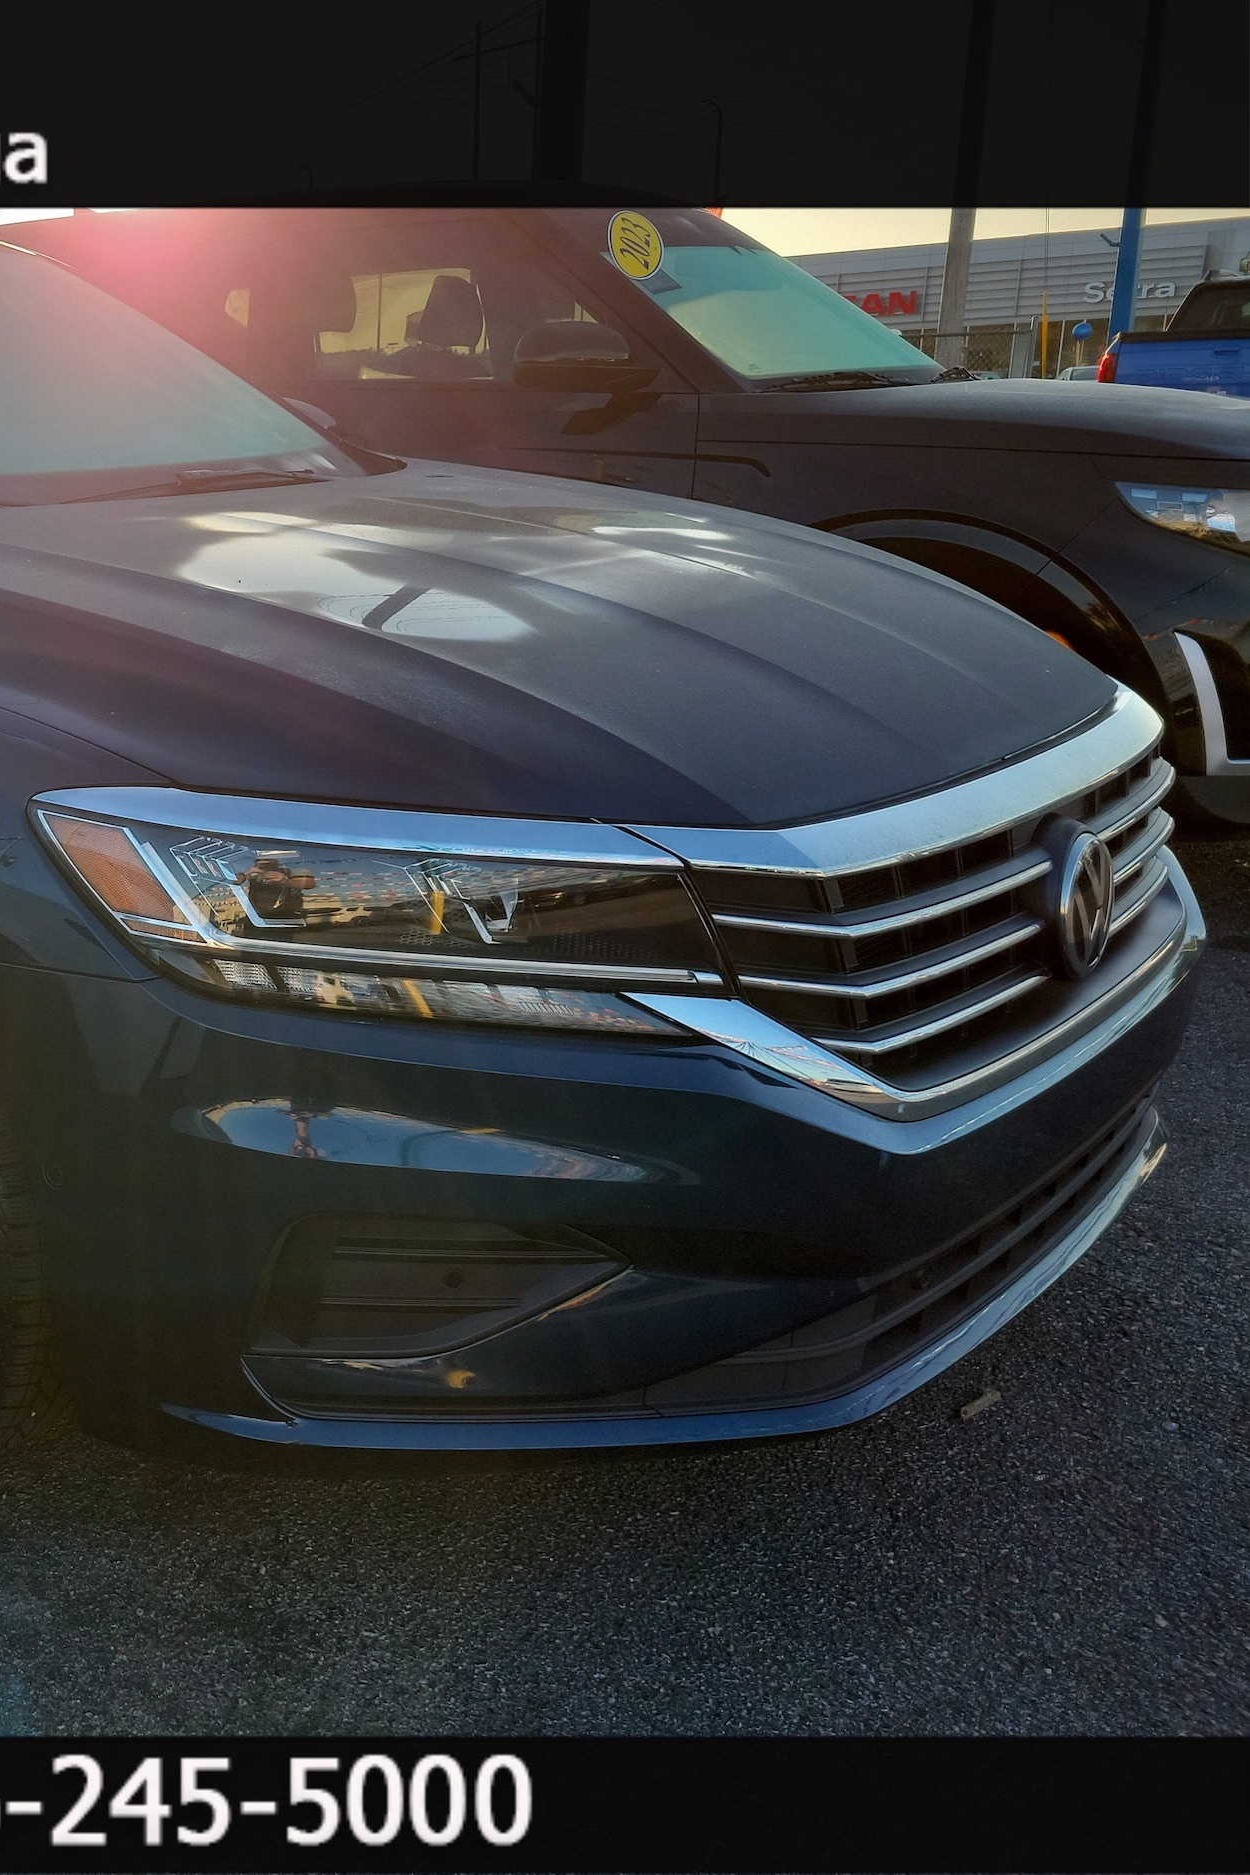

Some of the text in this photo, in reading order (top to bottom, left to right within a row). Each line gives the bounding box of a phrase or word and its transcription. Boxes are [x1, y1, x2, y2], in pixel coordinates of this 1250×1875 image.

[619, 217, 651, 270] 2023
[844, 290, 918, 317] AN
[1082, 281, 1176, 303] Sra
